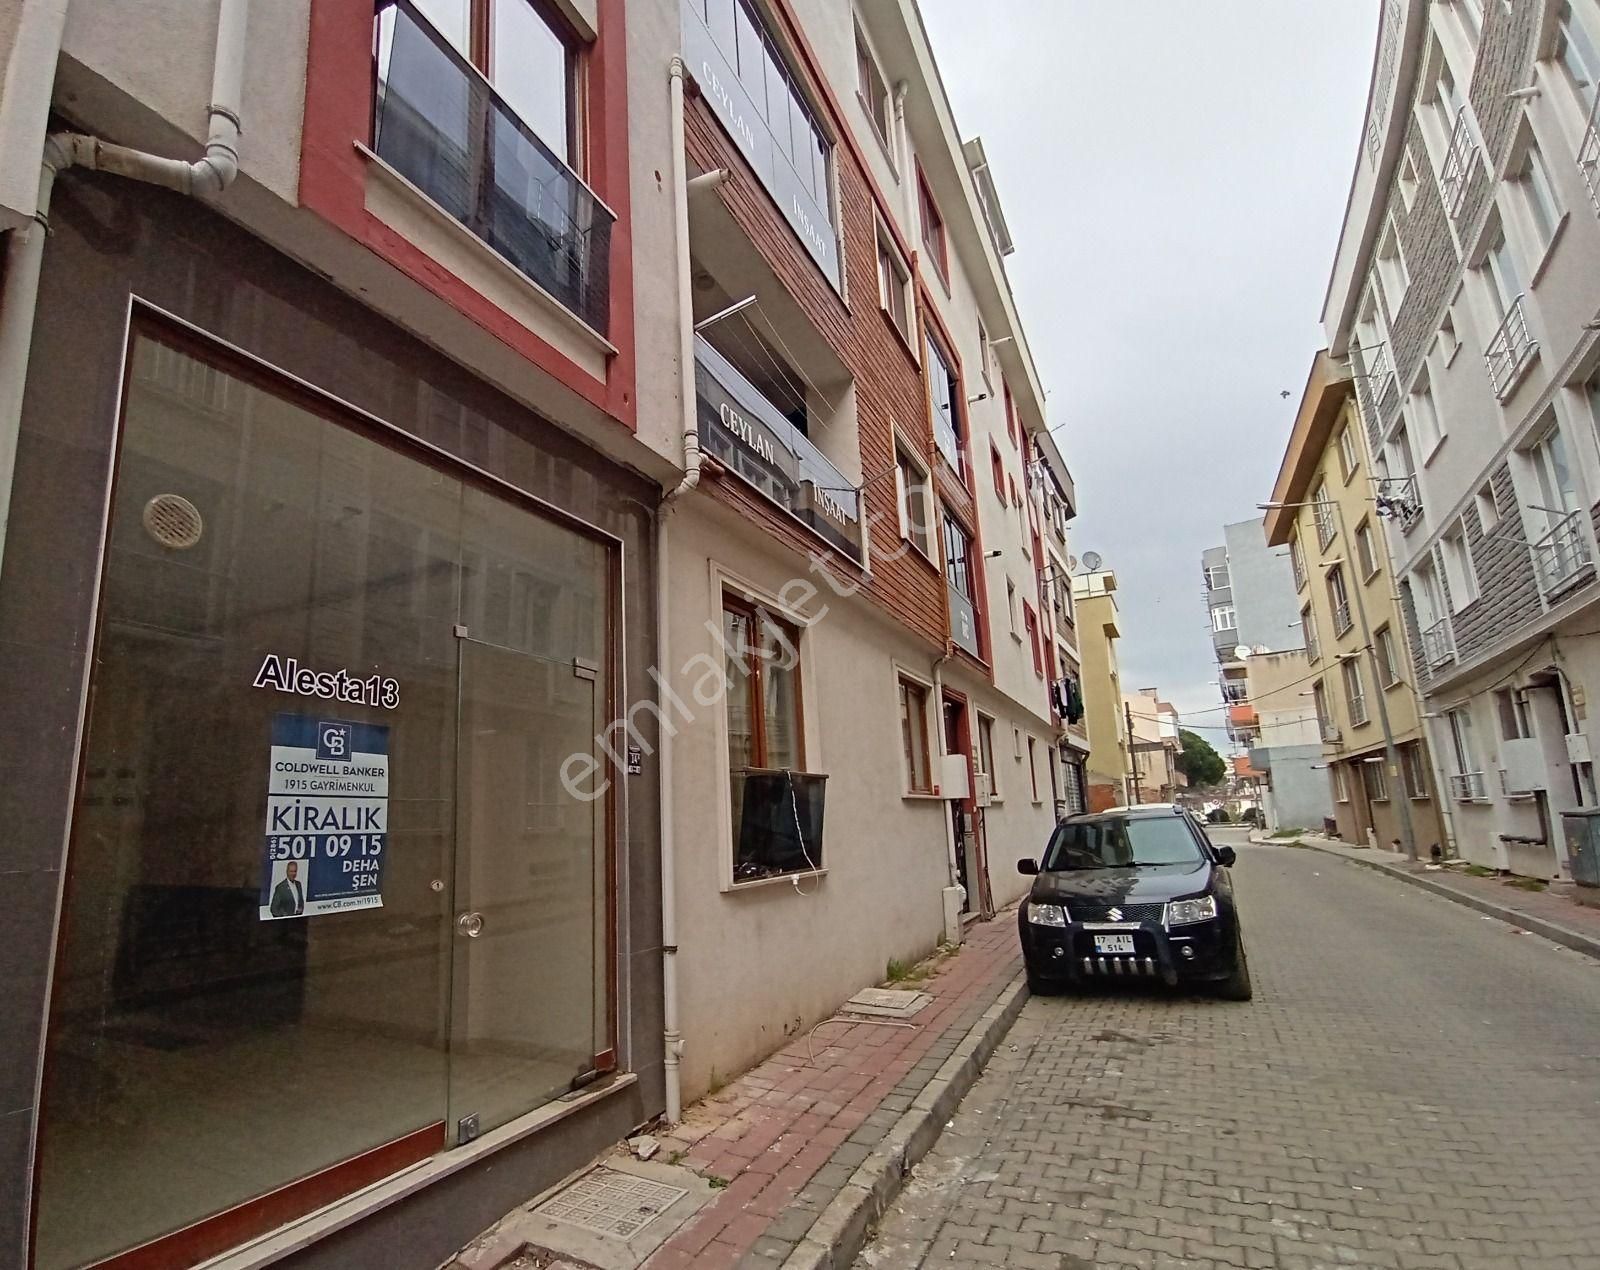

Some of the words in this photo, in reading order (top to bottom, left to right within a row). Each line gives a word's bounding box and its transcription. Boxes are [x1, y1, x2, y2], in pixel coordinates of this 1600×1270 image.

[701, 61, 755, 151] CEYLAN
[719, 401, 775, 466] CEYLAN
[253, 653, 401, 710] Alesta13
[274, 761, 340, 775] COLDWELL
[342, 765, 385, 778] BANKER
[284, 779, 308, 791] 1915
[310, 779, 376, 793] GAYRİMENKUL
[271, 798, 382, 832] KİRALIK
[276, 835, 316, 860] 501
[325, 834, 352, 858] 09
[360, 834, 382, 856] 15
[342, 858, 380, 873] DEHA
[351, 873, 378, 891] ŞEN
